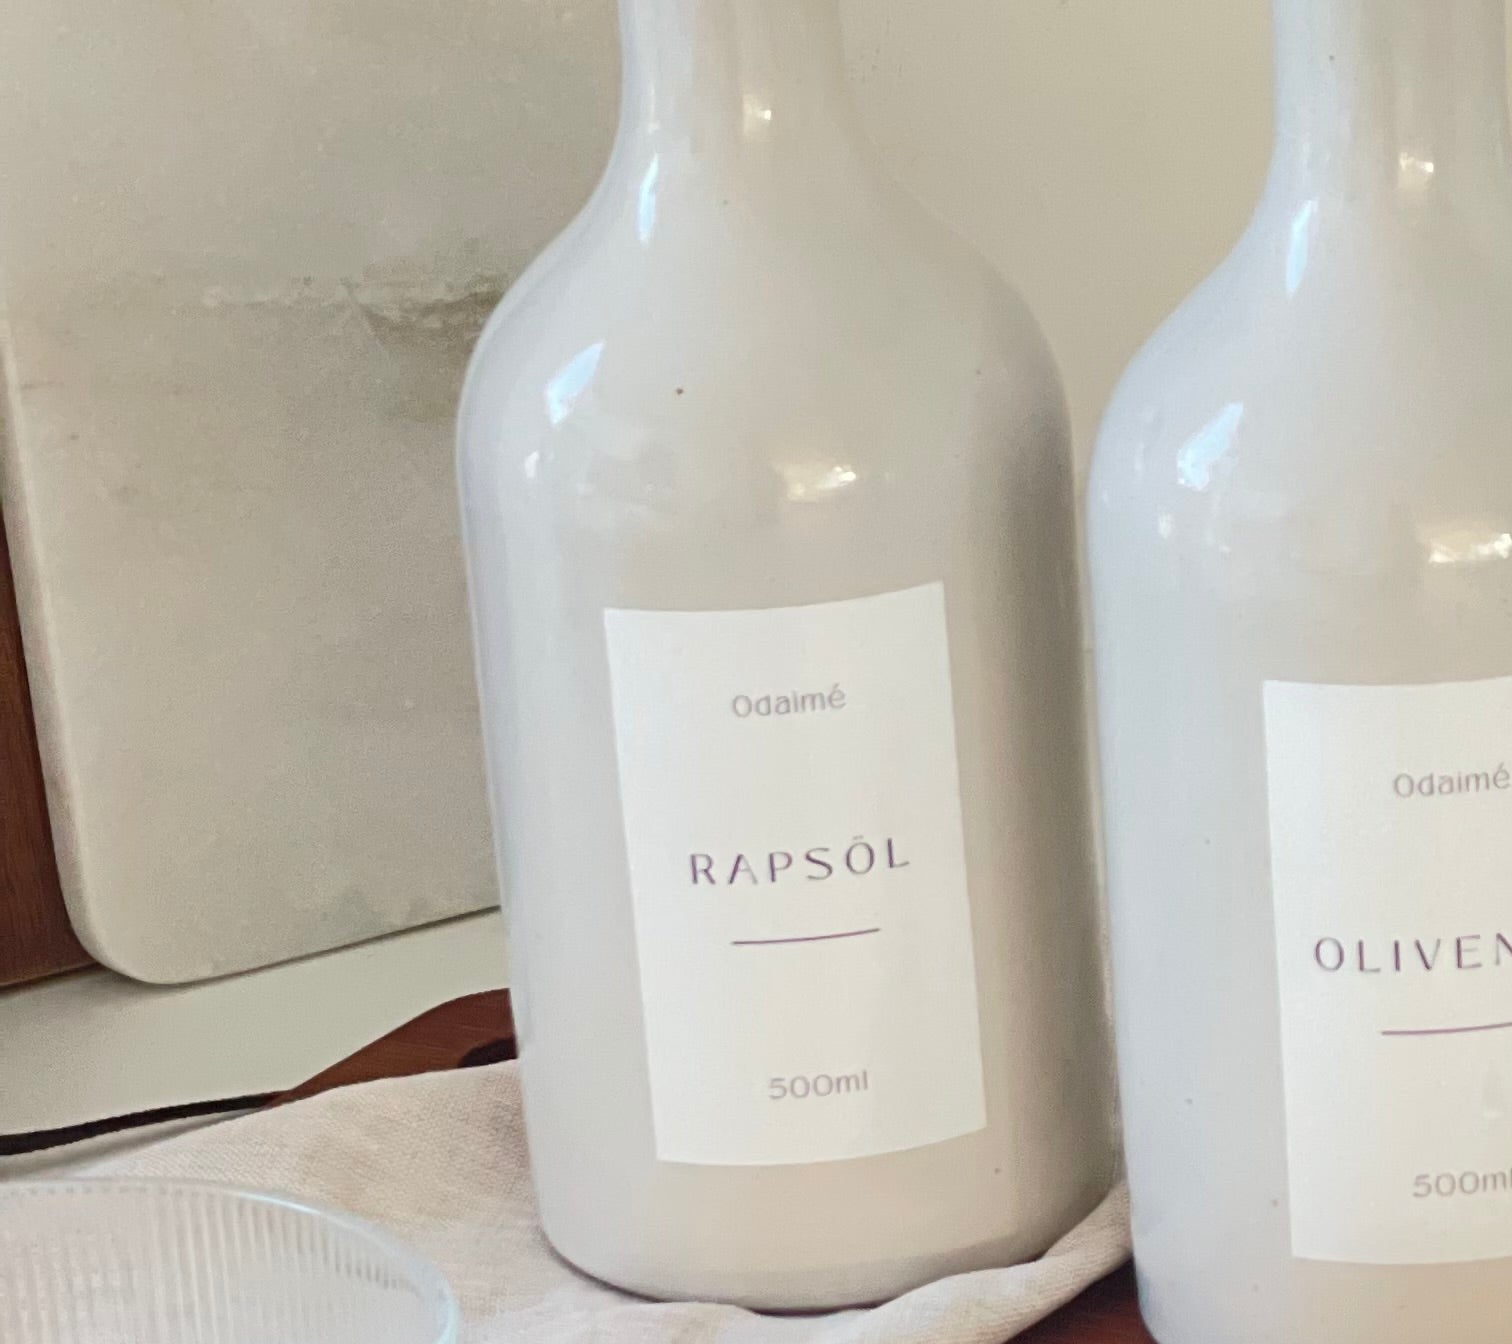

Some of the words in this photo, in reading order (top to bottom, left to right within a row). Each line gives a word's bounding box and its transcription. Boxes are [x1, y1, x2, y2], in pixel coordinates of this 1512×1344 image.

[731, 683, 846, 718] Odaimé
[1394, 763, 1511, 798] Odaimé
[689, 836, 910, 886] RAPSÖL
[768, 1070, 868, 1100] 500ml
